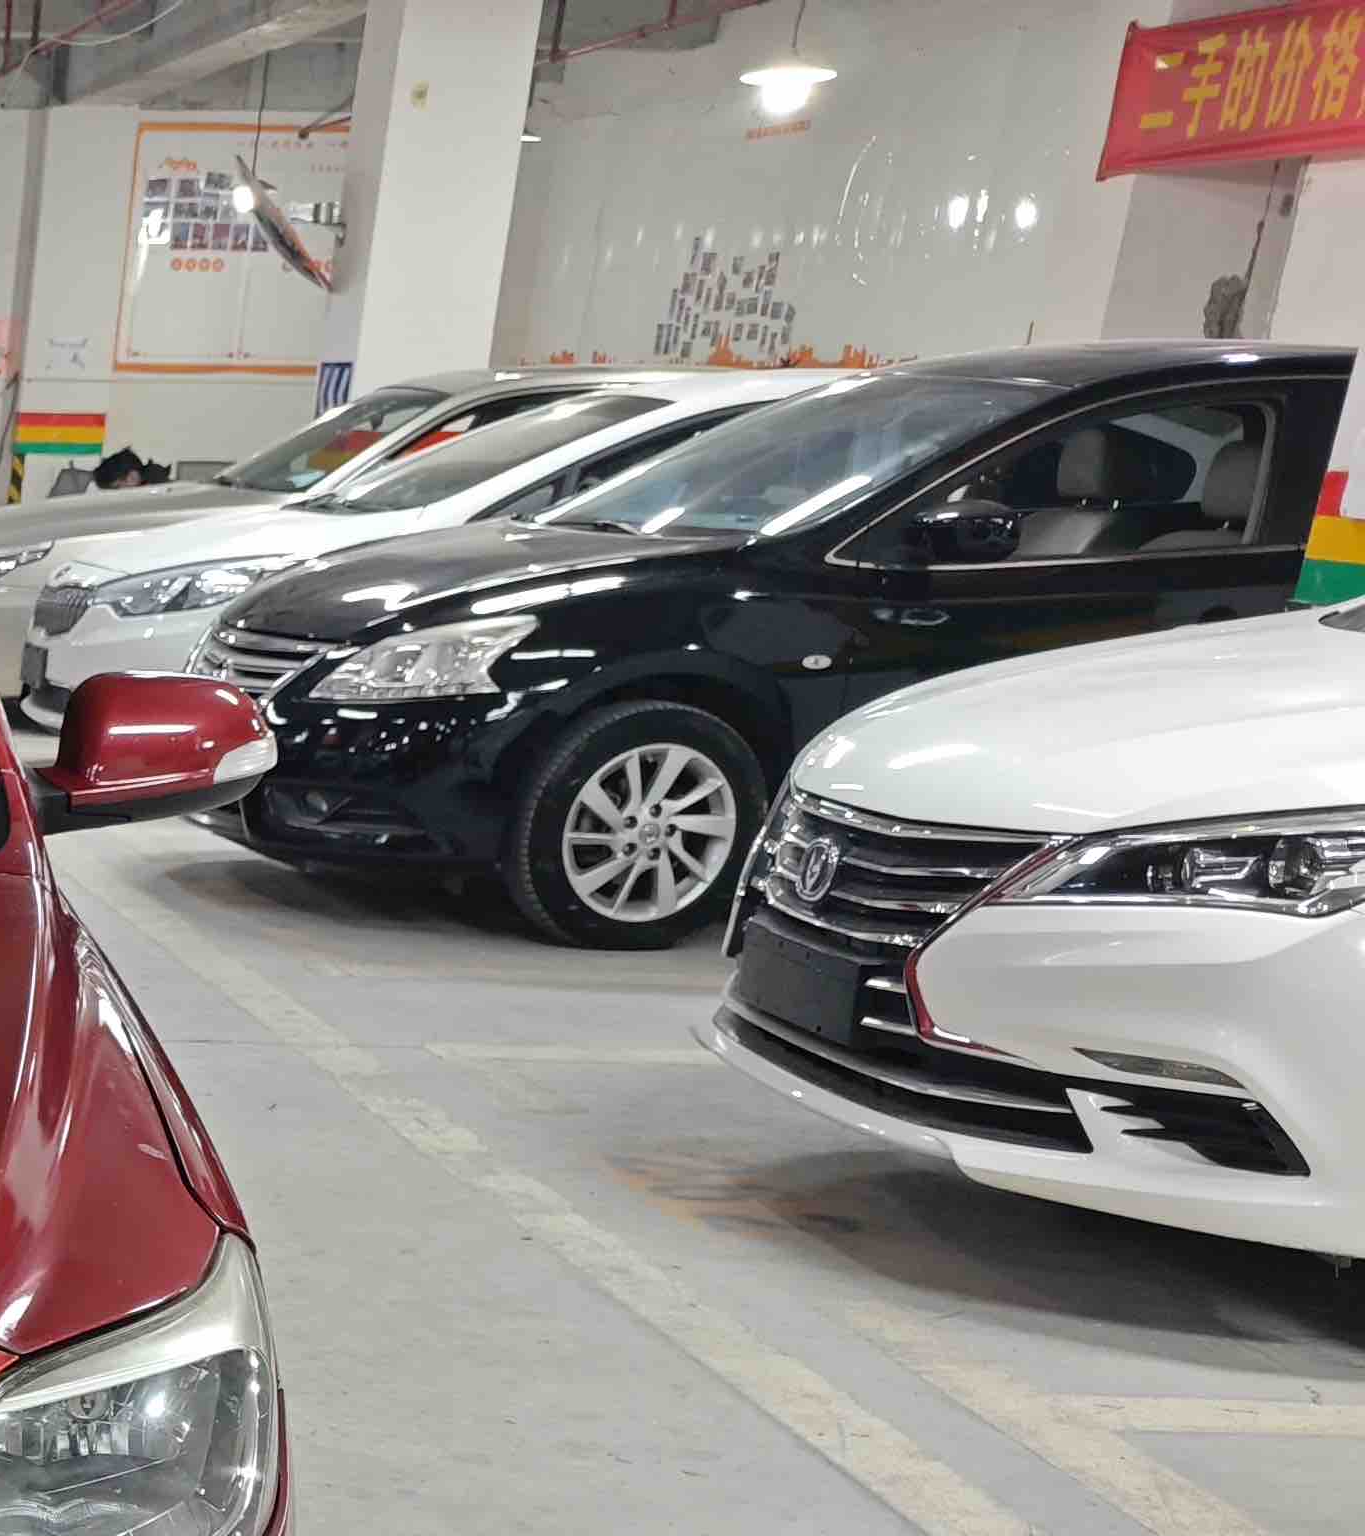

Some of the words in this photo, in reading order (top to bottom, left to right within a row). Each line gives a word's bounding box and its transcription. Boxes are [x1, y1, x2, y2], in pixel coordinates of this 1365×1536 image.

[1139, 7, 1365, 139] 二手的价格
